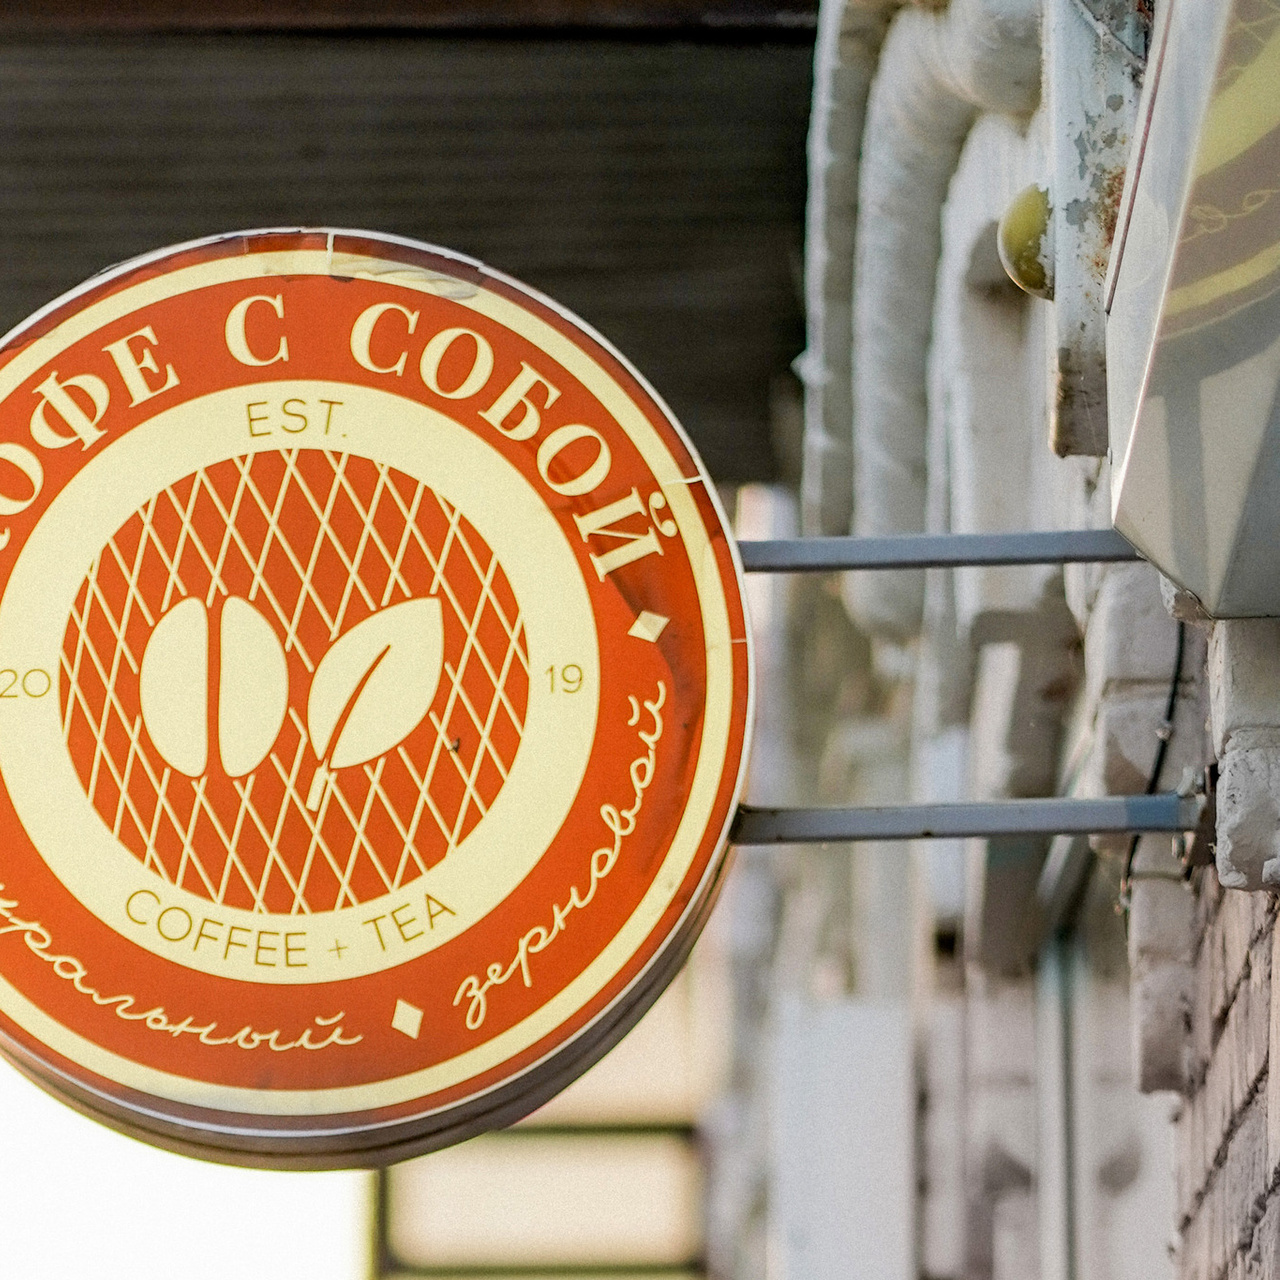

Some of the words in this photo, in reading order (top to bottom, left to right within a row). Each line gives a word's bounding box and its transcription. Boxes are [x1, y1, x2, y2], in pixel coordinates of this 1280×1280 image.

[224, 294, 289, 367] С
[349, 302, 679, 583] СОБОЙ
[247, 398, 347, 439] EST.
[546, 664, 584, 695] 19
[453, 680, 666, 1028] зерновой
[125, 888, 308, 967] COFFEE
[362, 893, 456, 952] TEA
